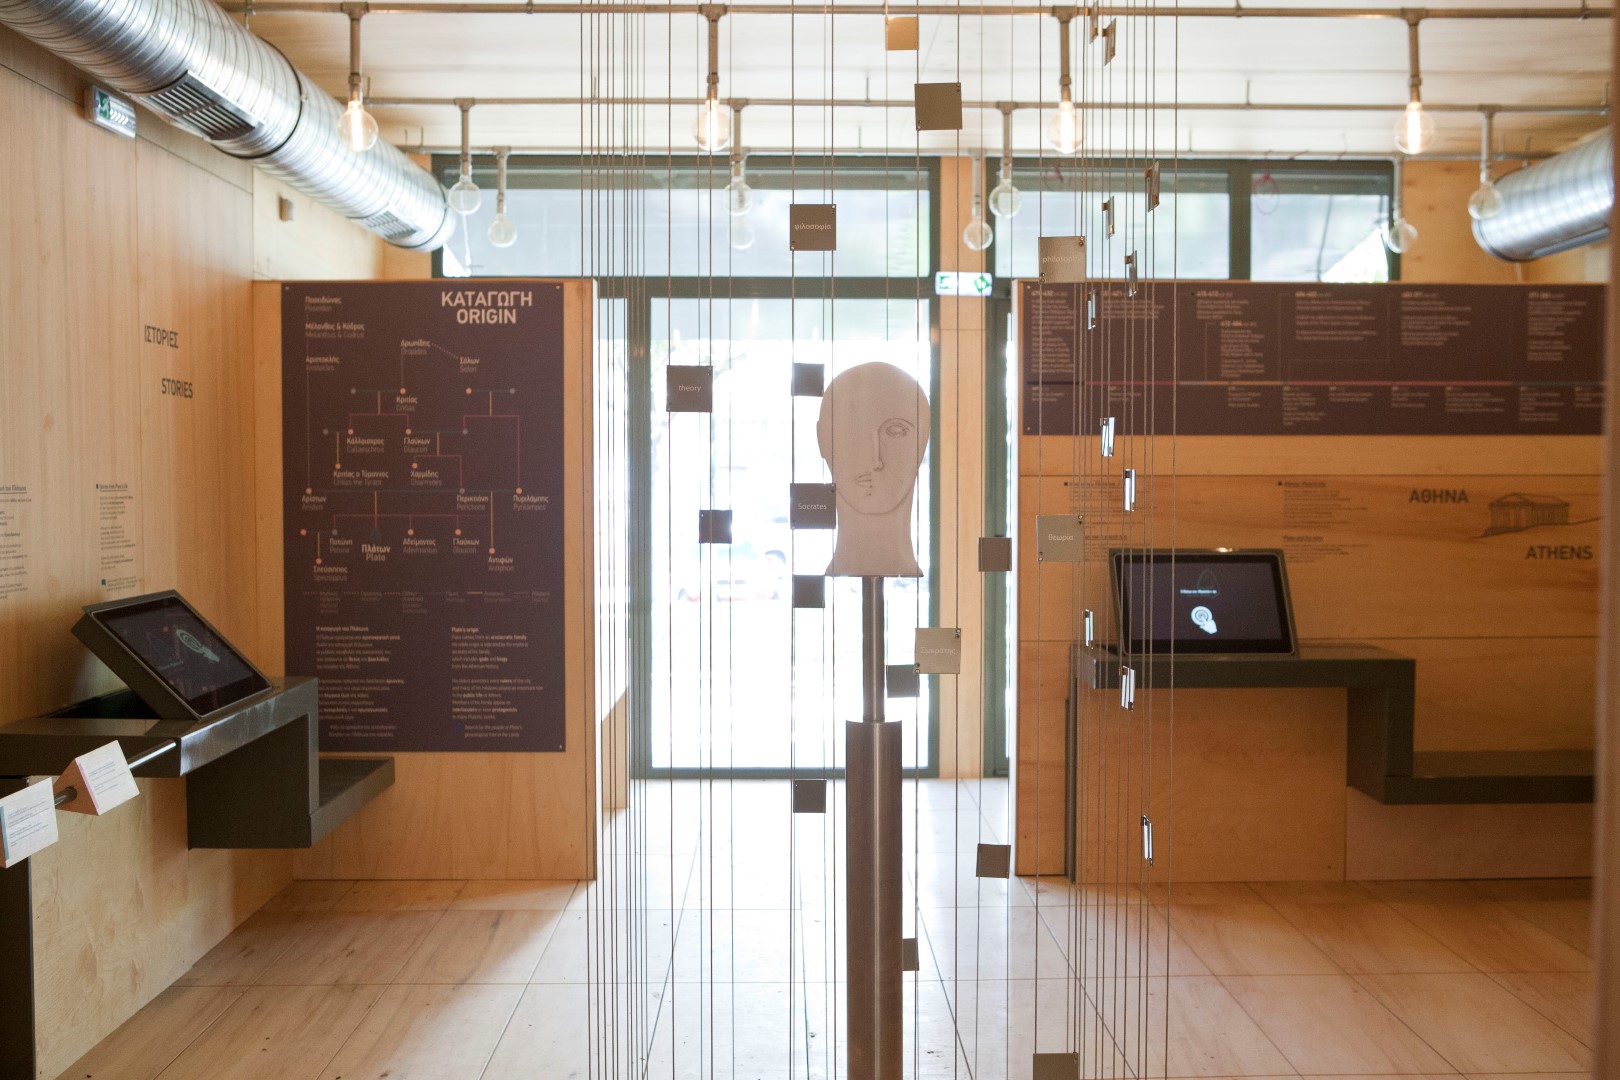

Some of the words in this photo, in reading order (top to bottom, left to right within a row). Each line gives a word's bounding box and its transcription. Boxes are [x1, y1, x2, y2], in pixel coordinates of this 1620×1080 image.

[794, 222, 832, 230] φιλοσοφία
[441, 291, 533, 307] ΚΑΤΑΓΩΓΗ
[456, 308, 517, 324] ORIGIN
[144, 324, 179, 348] ΙΣΤΟΡΙΕΣ
[161, 378, 193, 399] STORIES
[678, 384, 702, 393] theory
[410, 470, 439, 478] Χαρμίδης
[1408, 489, 1470, 504] ΑΘΗΝΑ
[797, 502, 827, 510] Socrates
[452, 538, 480, 546] Γλαύκων
[362, 544, 391, 553] Πλάτων
[1525, 545, 1594, 561] ATHENS
